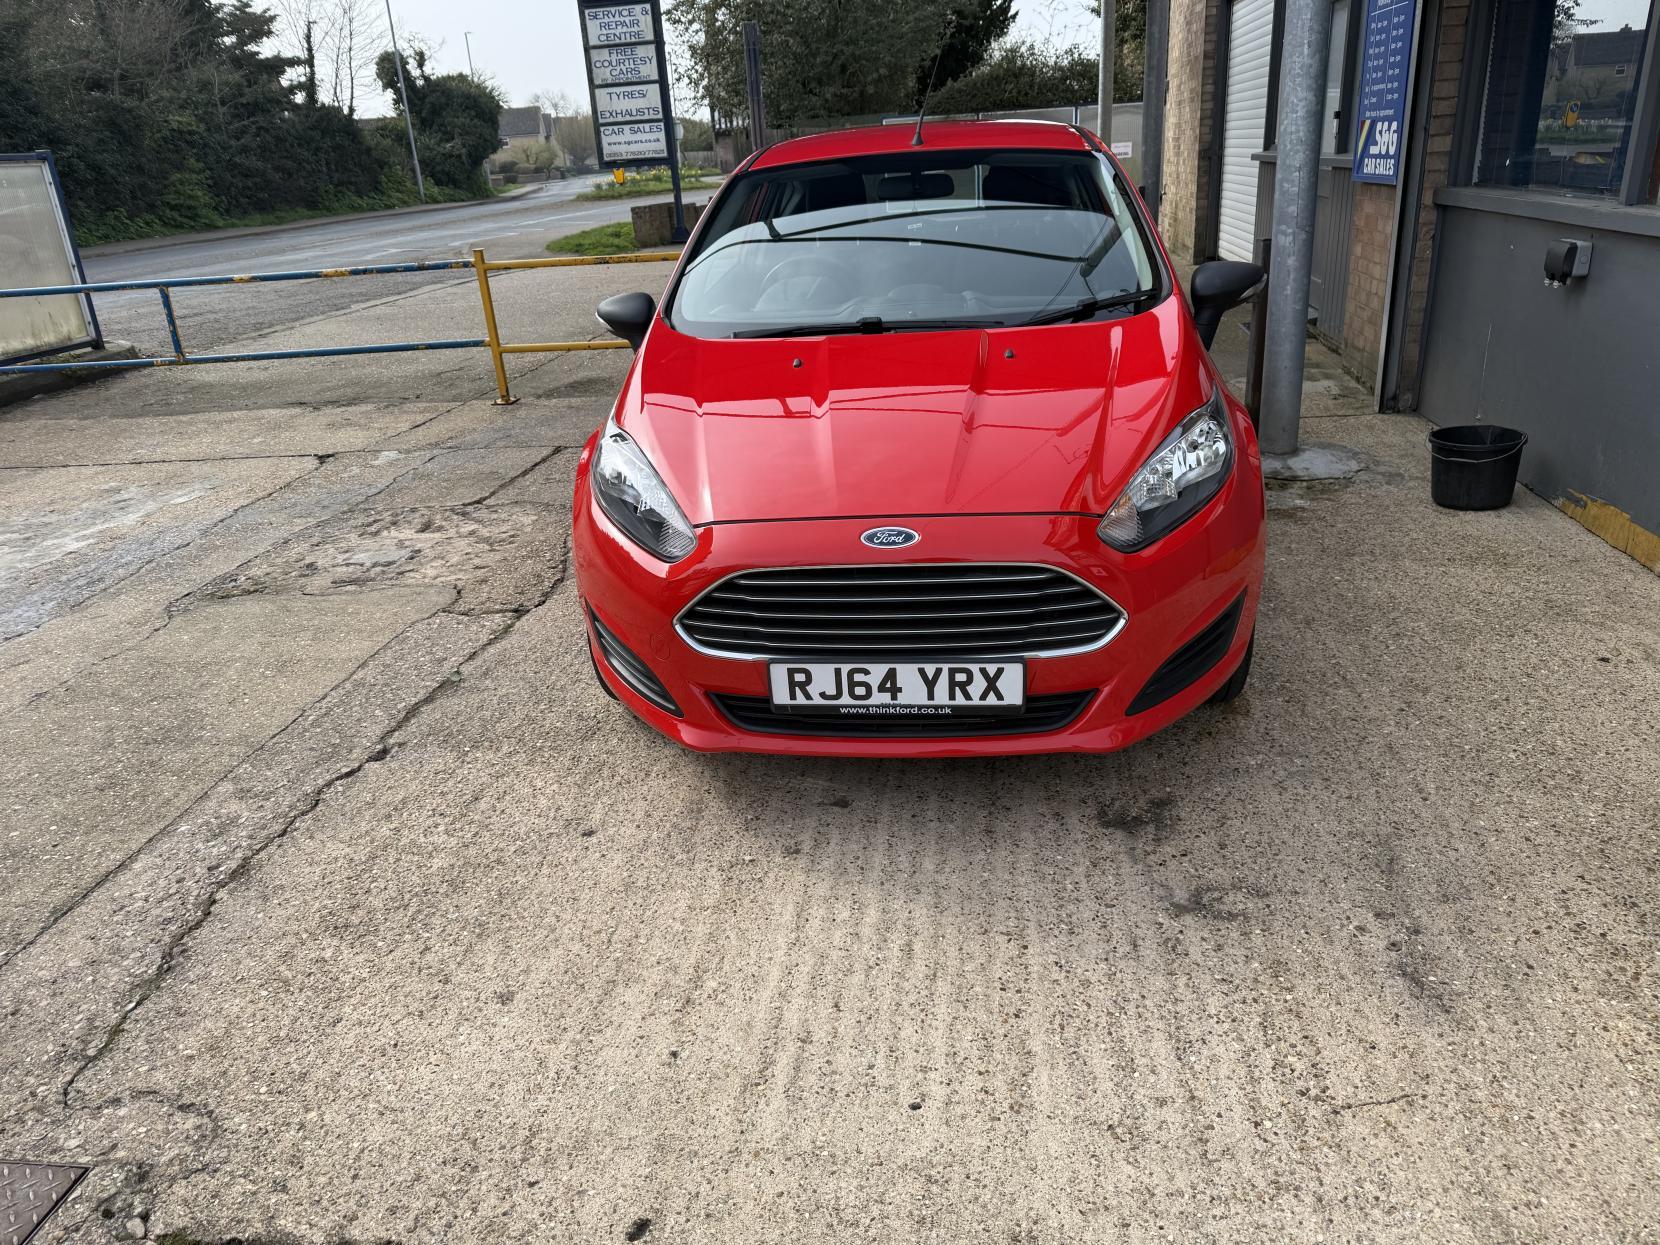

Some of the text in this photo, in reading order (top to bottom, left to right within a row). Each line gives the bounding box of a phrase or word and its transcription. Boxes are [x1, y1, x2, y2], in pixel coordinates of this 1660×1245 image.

[587, 6, 650, 21] SERVICE &
[599, 19, 640, 32] REPAIR
[597, 30, 646, 43] CENTRE
[608, 47, 638, 58] FREE
[593, 56, 654, 69] COURTESY
[609, 67, 641, 77] CARS
[600, 106, 660, 120] EXHAUSTS
[602, 124, 663, 137] CAR SALES
[607, 137, 661, 147] www.sgcars.co.uk
[1363, 158, 1394, 175] CAR SALES
[873, 530, 905, 544] Ford
[786, 667, 1005, 702] RJ64 YRX
[839, 706, 952, 714] www.thinkford.co.uk
